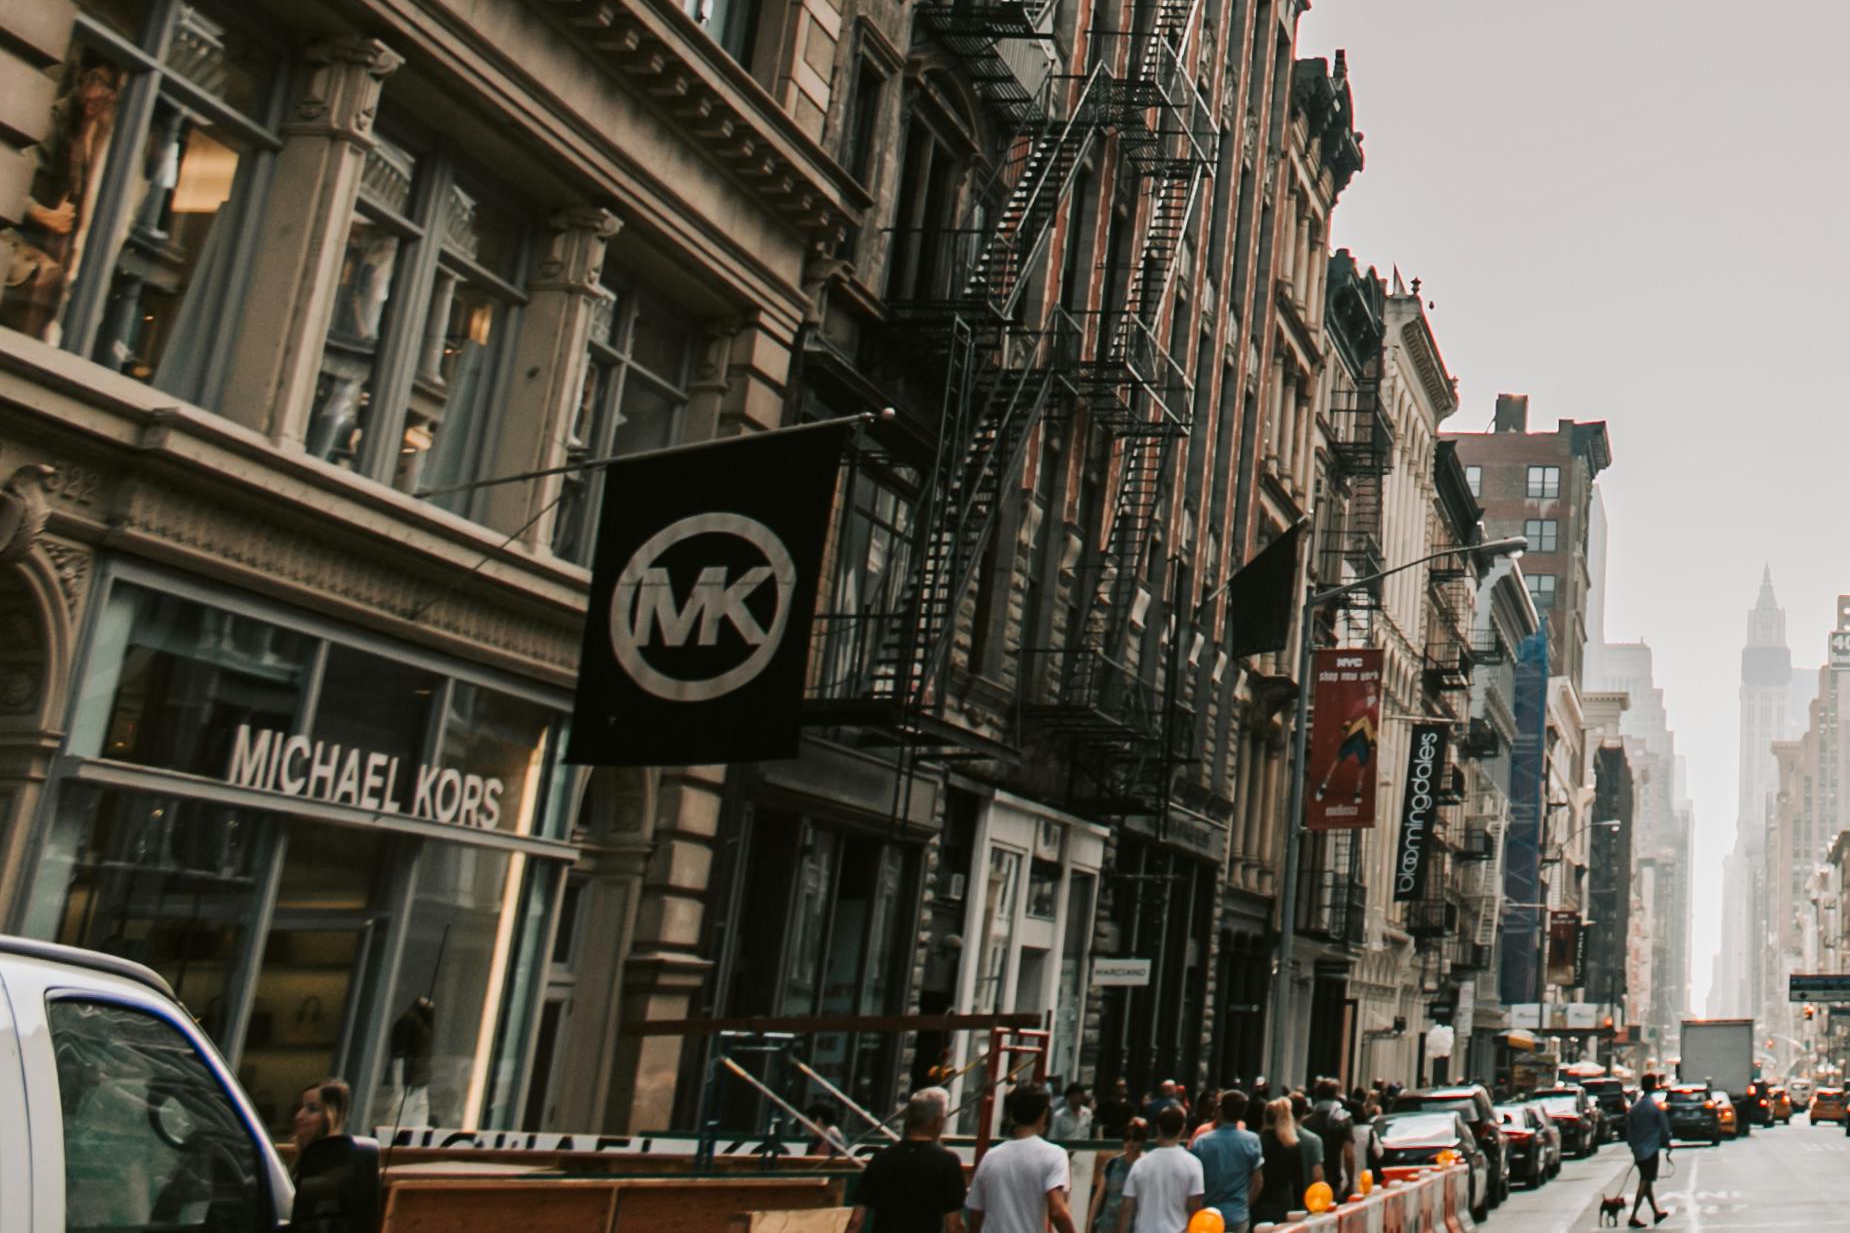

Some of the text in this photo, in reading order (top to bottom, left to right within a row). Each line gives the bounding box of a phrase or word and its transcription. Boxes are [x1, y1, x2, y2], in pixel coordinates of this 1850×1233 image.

[633, 566, 772, 647] MK
[1336, 657, 1363, 668] NYC
[228, 723, 504, 831] MICHAEL KORS
